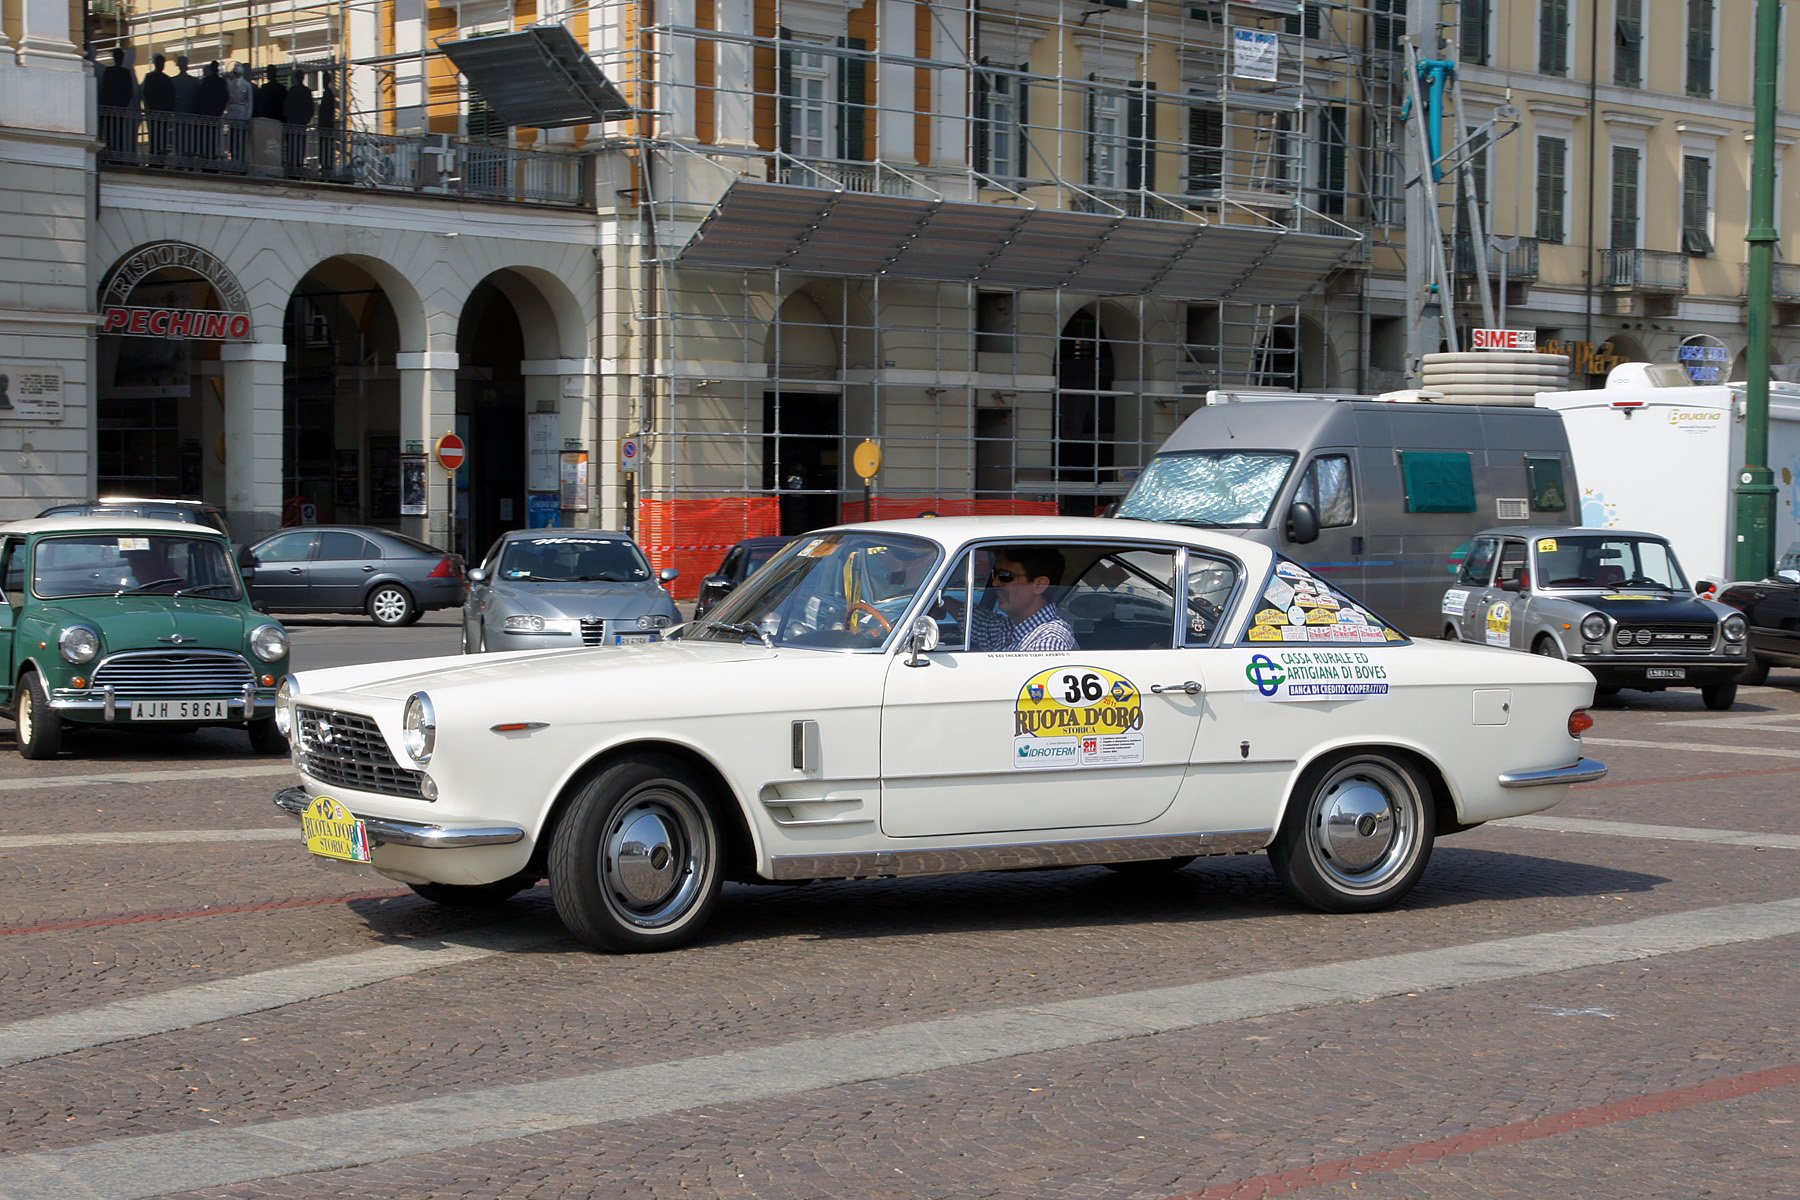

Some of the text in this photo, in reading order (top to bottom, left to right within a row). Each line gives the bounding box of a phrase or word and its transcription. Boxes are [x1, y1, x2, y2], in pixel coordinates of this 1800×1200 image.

[111, 245, 244, 307] RISTORANTE
[103, 307, 251, 338] PECHINO
[1474, 330, 1517, 348] SIME
[1281, 652, 1369, 665] CASSA RURALE ED
[1287, 665, 1387, 680] ARTIGIANA DI BOVES
[1063, 674, 1103, 704] 36
[1290, 684, 1387, 695] BANCA DI CREDITO COOPERATIVO
[136, 701, 223, 718] AJH 586A
[1103, 697, 1118, 707] 2011
[1014, 706, 1144, 737] RUOTA D'ORO
[1062, 726, 1097, 734] STORICA
[1028, 746, 1076, 758] IDROTERM
[304, 816, 333, 840] RUOTA
[319, 837, 352, 855] STORICA
